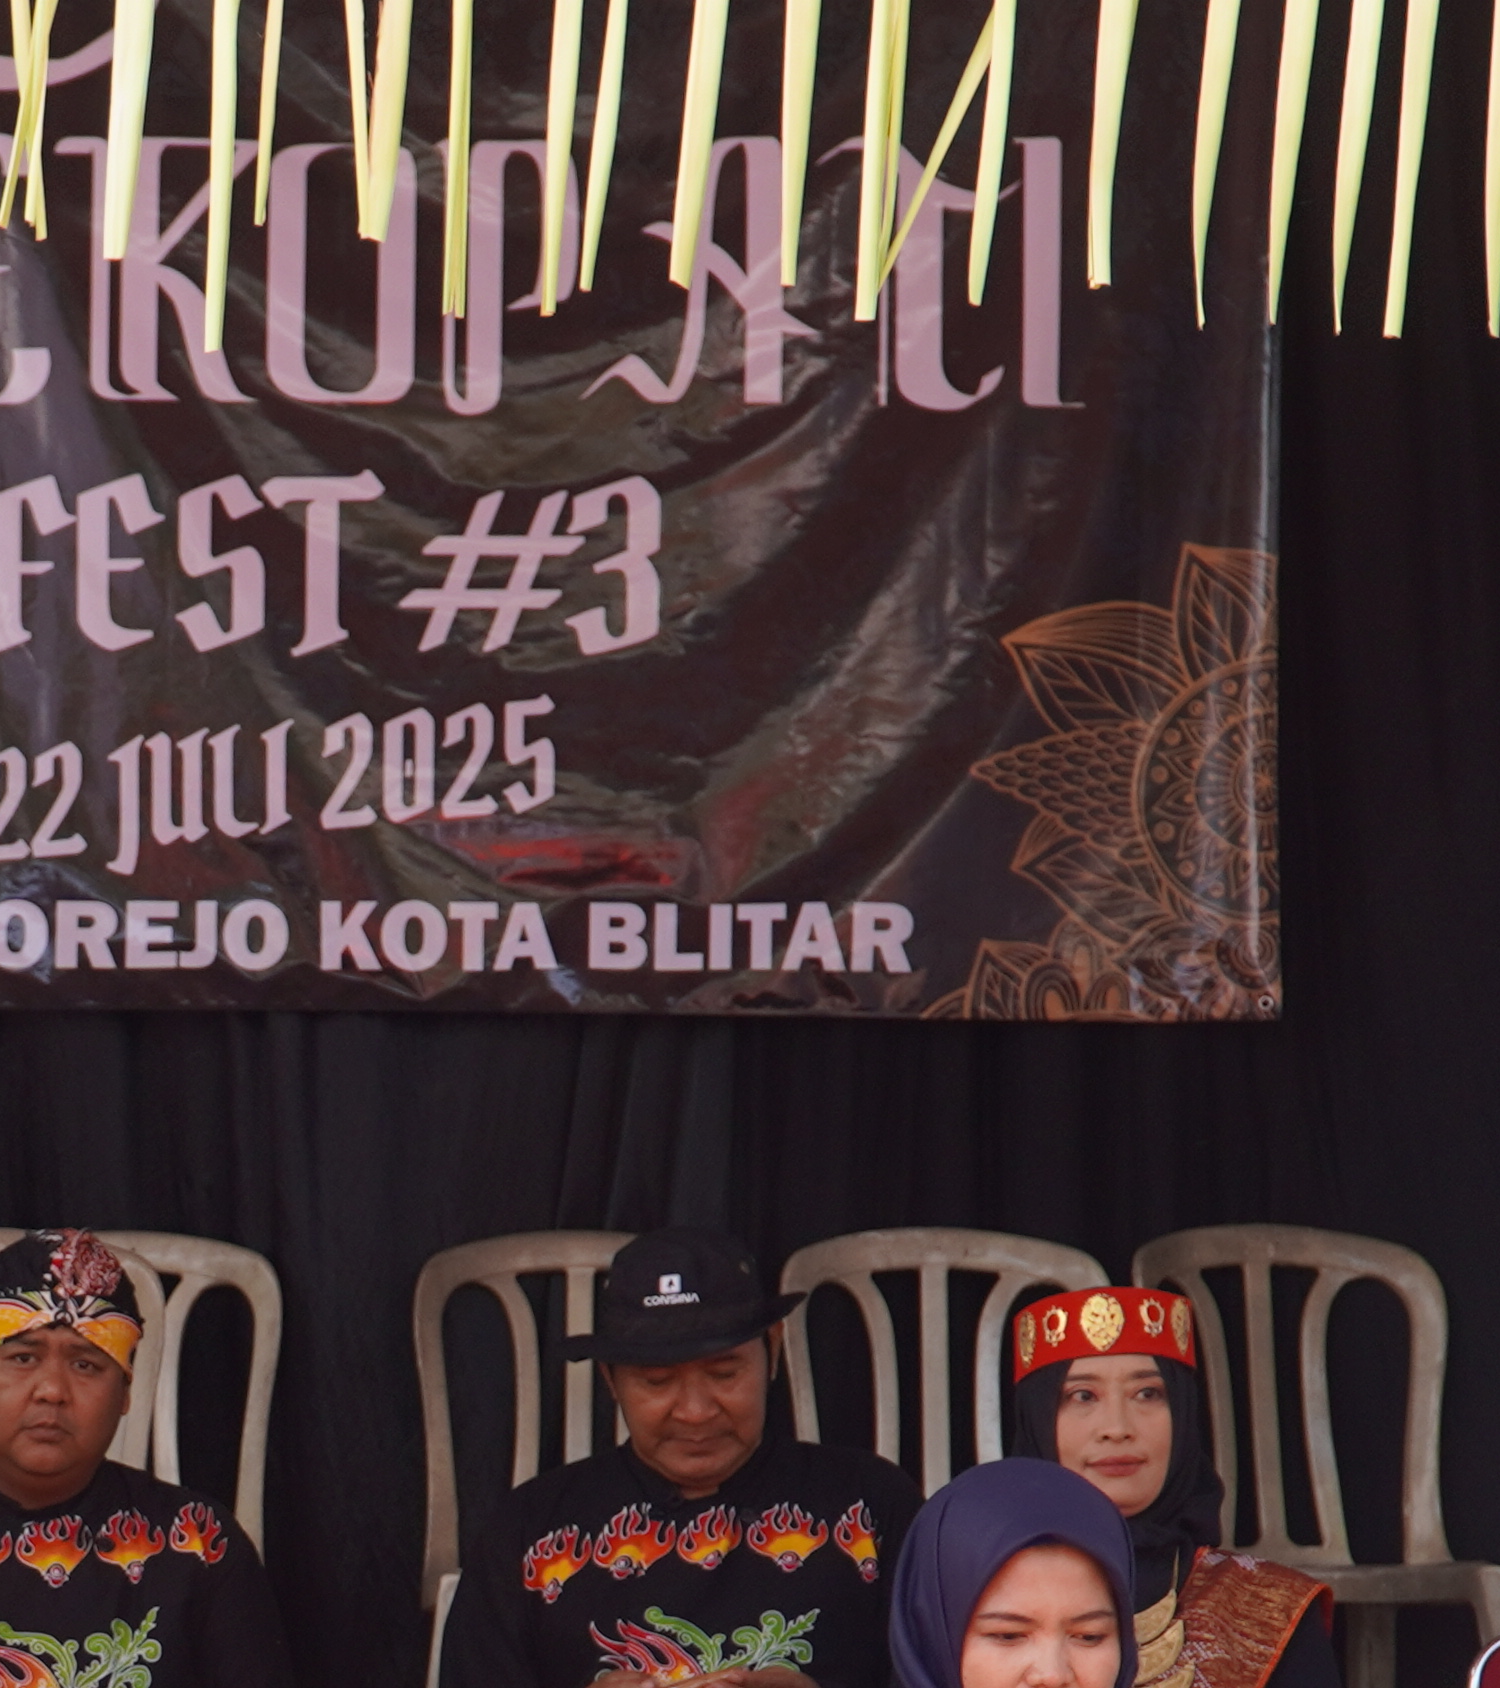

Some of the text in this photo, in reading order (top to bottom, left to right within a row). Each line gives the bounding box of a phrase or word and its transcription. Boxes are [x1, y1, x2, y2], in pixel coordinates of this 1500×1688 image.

[398, 474, 663, 656] #3
[106, 717, 295, 876] JULI
[319, 693, 556, 831] 2025
[319, 899, 558, 971] KOTA
[588, 900, 915, 974] BLITAR
